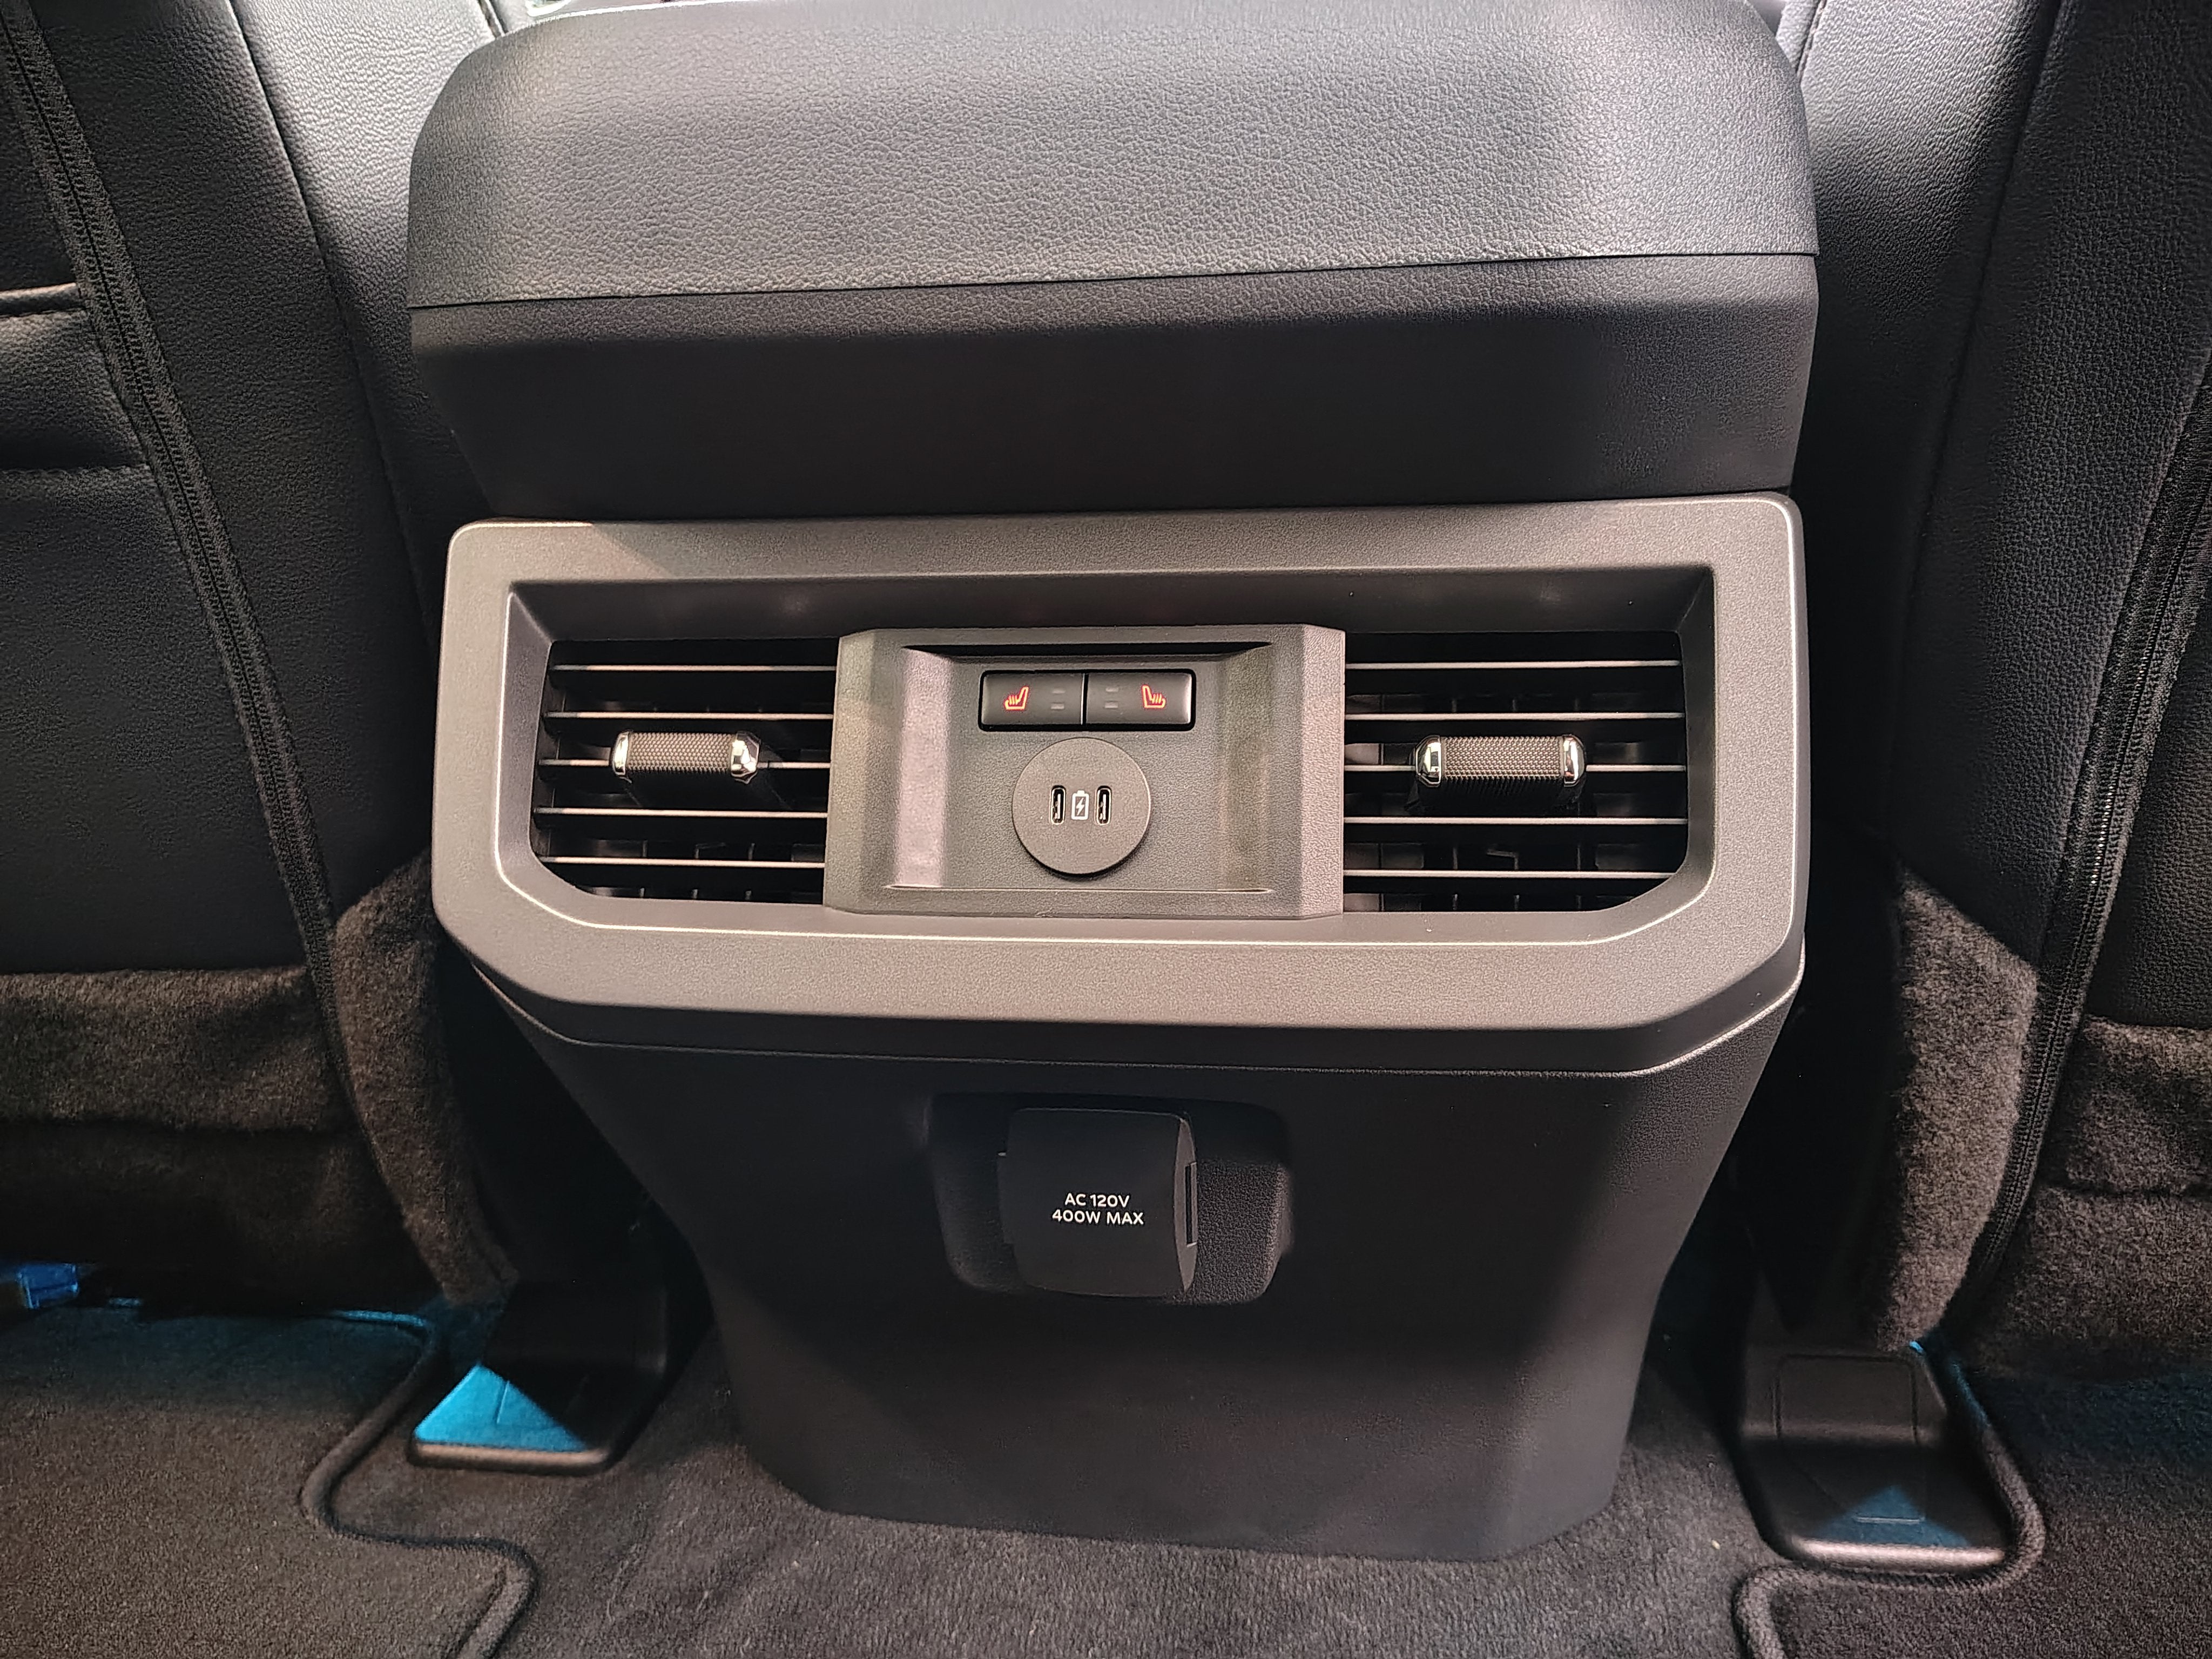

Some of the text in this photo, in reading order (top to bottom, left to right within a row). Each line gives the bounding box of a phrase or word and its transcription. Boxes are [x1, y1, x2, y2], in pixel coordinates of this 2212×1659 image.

[1064, 1192, 1130, 1208] AC 120V
[1052, 1209, 1144, 1225] 400W MAX
